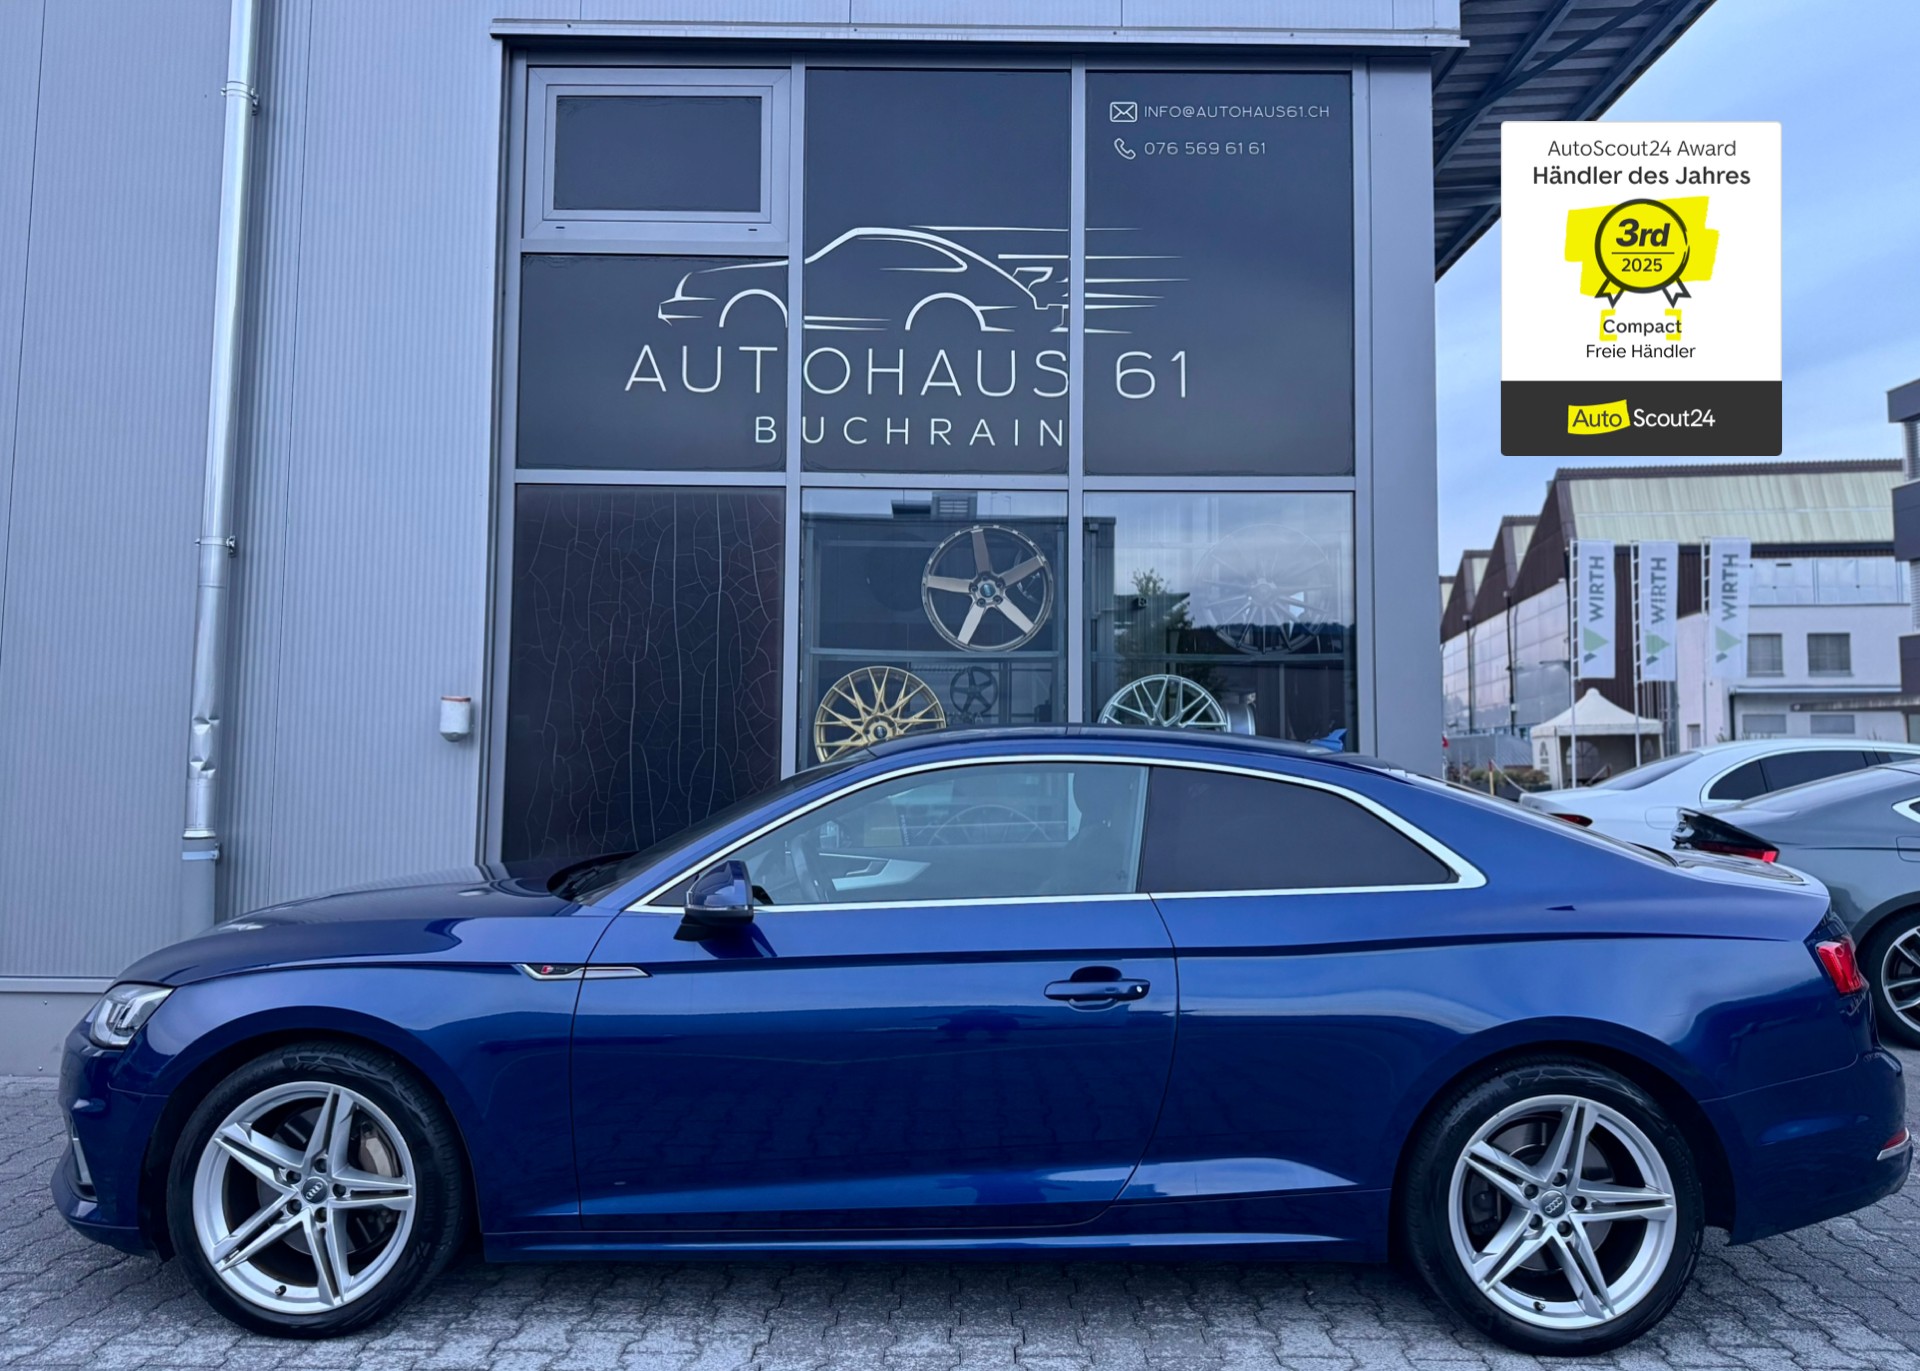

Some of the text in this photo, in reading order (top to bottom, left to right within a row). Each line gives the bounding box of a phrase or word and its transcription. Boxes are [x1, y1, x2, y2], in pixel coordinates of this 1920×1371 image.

[1144, 105, 1330, 119] INFO@AUTOHAUS61.CH
[1144, 141, 1266, 155] 076 569 61 61
[624, 344, 1188, 399] AUTOHAUS 61
[754, 416, 1064, 447] BUCHRAIN
[1589, 555, 1605, 622] WIRTH
[1651, 557, 1667, 624] WIRTH
[1722, 553, 1739, 621] WIRTH
